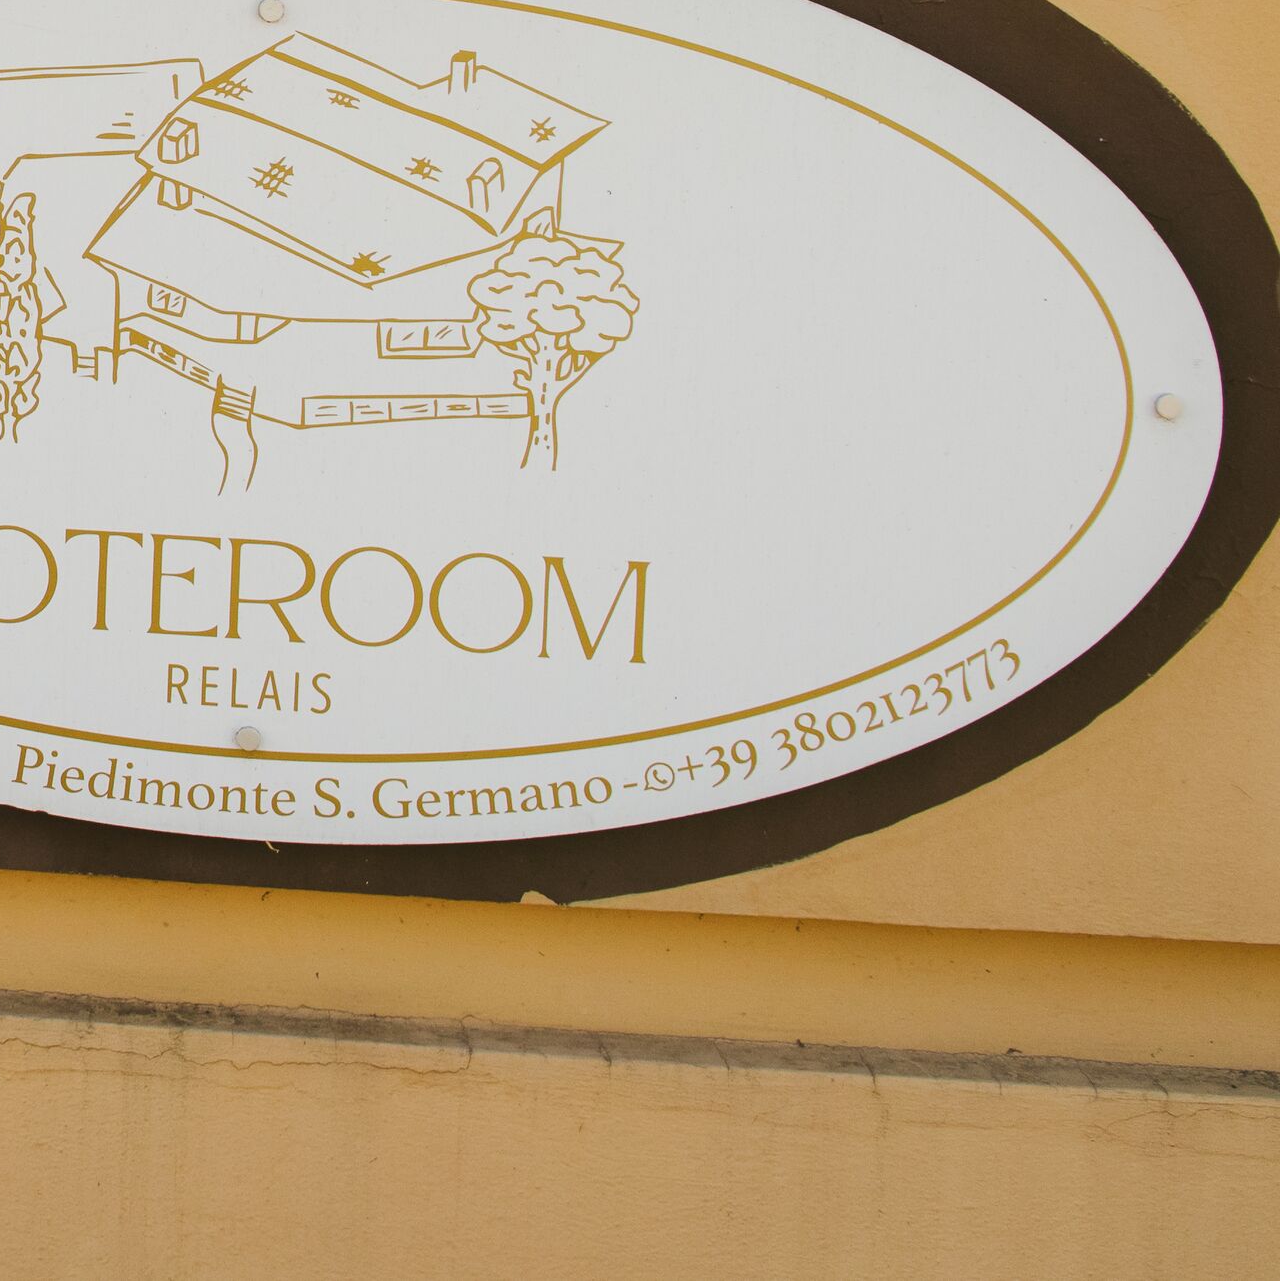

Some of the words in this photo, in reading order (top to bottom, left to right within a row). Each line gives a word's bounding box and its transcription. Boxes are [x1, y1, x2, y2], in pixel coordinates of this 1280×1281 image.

[11, 744, 297, 817] Piedimonte
[313, 778, 356, 819] S.
[372, 775, 613, 819] Germano
[771, 638, 1022, 771] 3802123773
[166, 663, 333, 715] RELAIS
